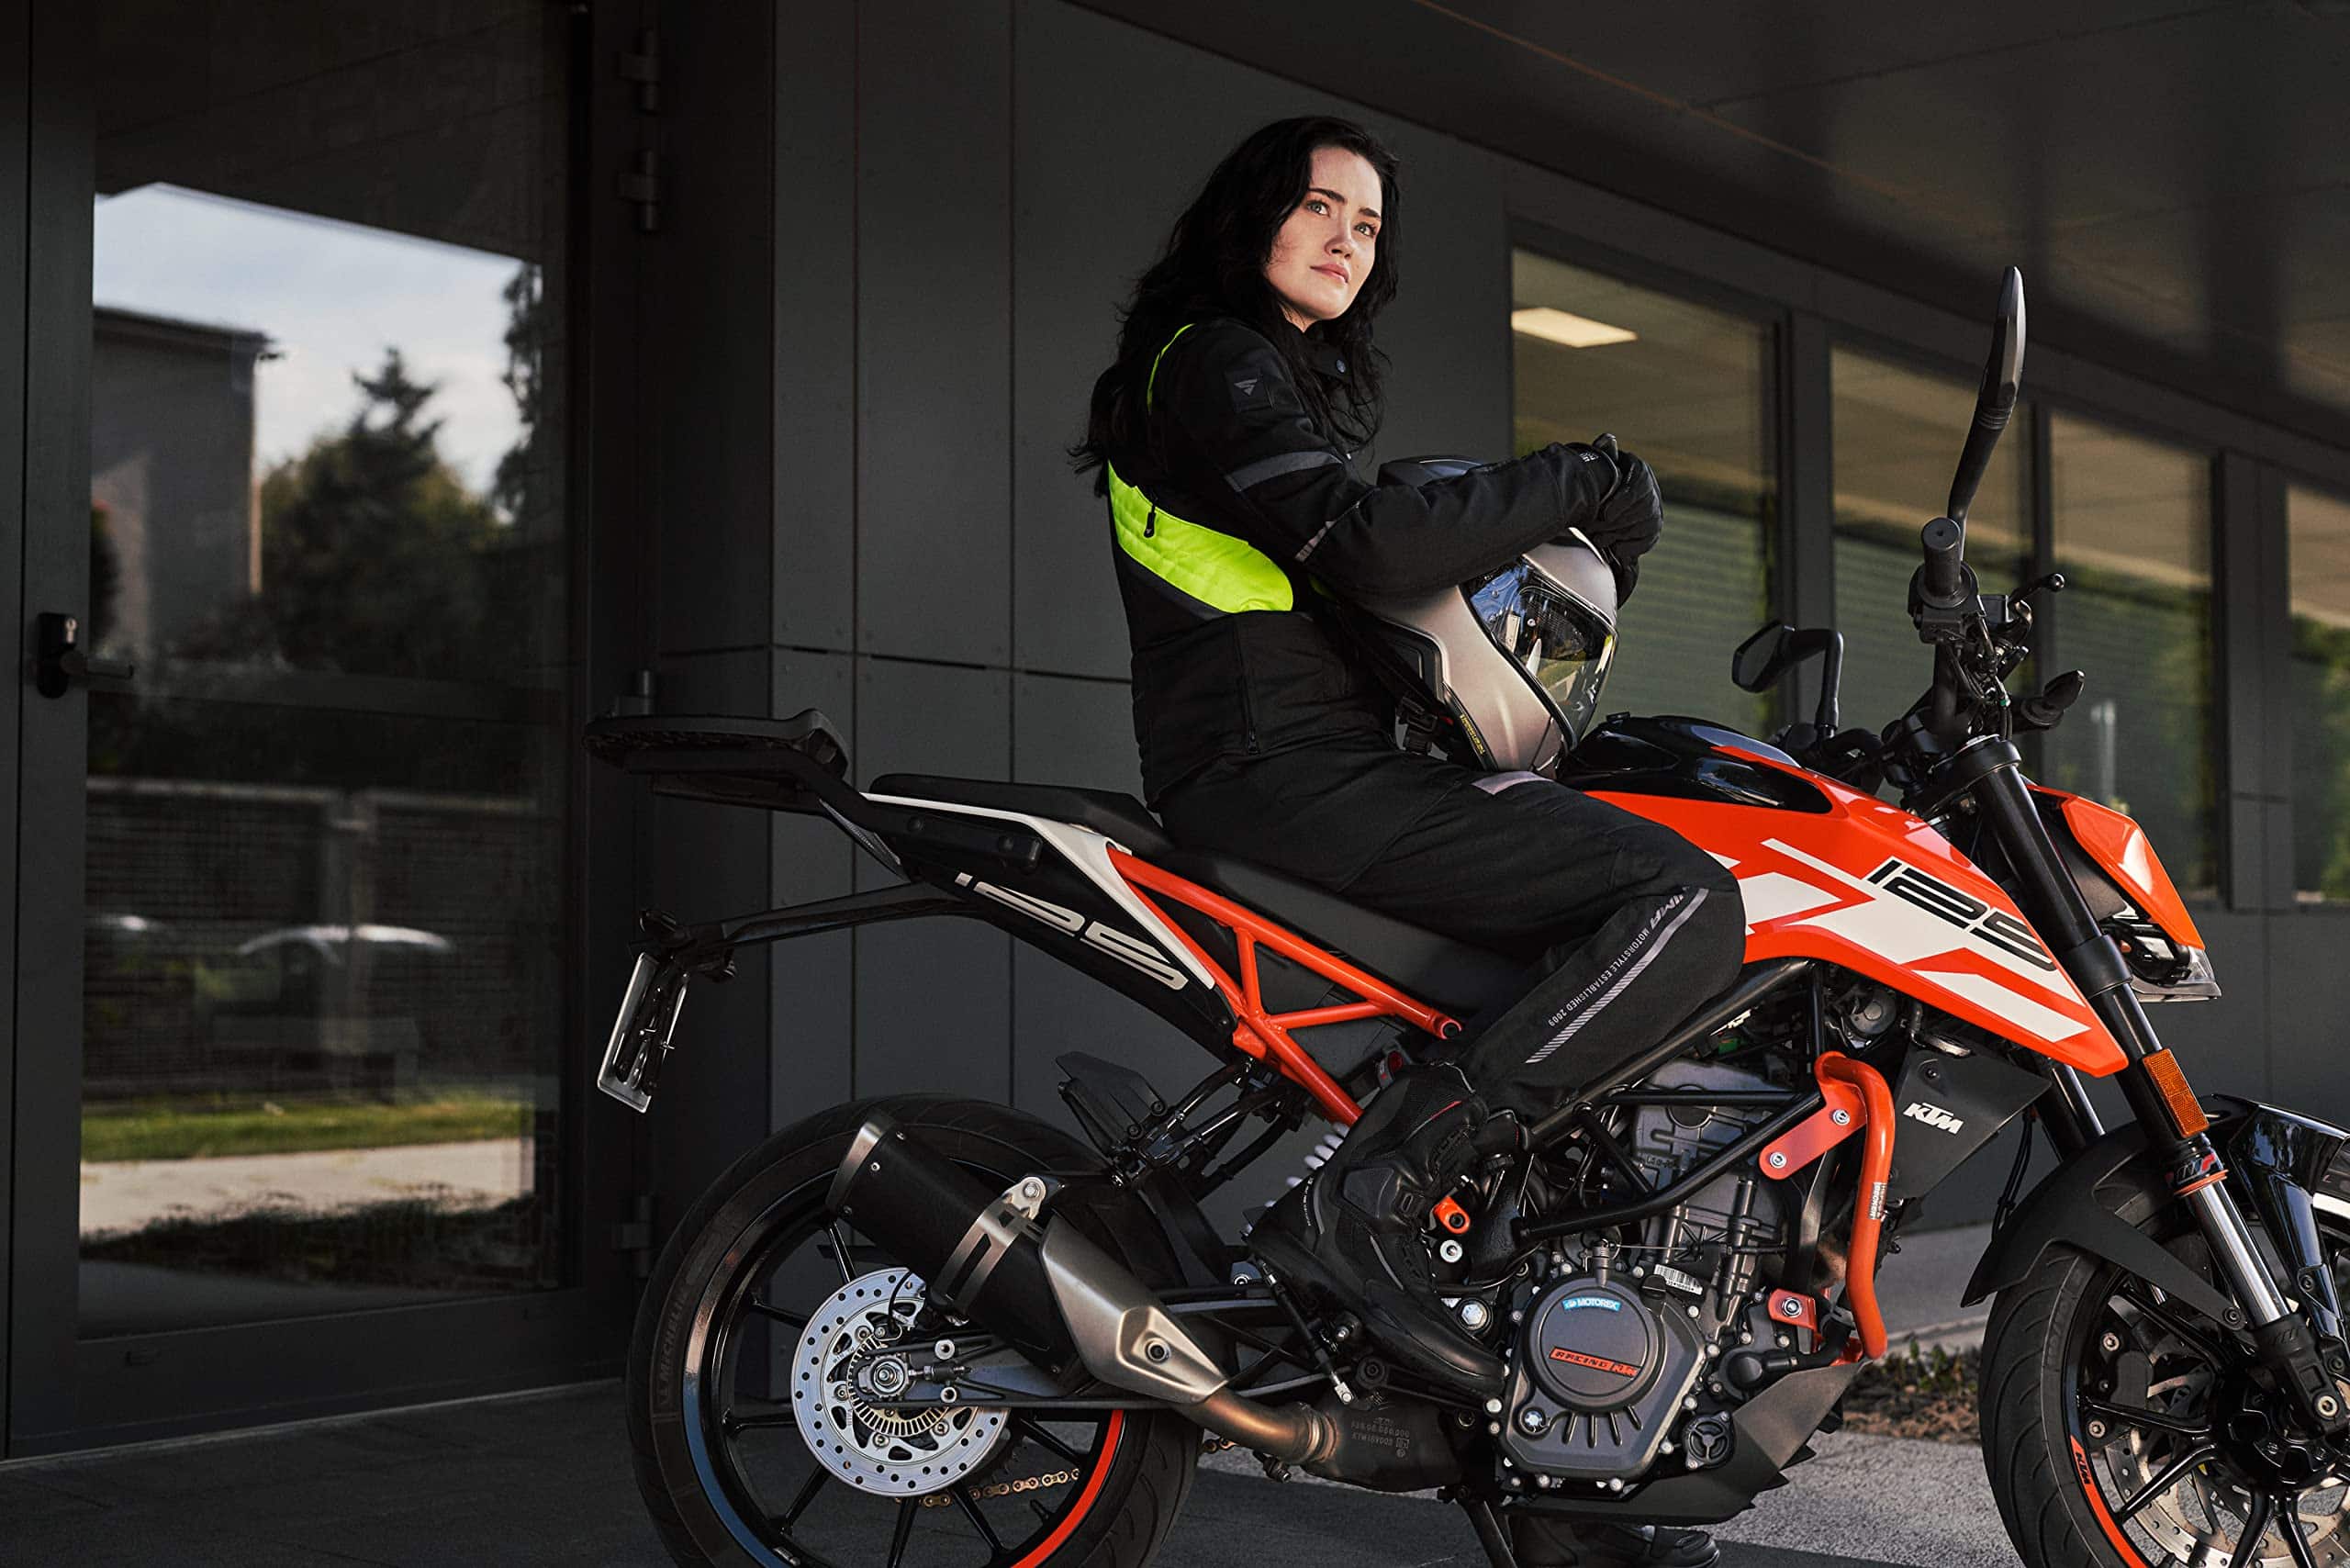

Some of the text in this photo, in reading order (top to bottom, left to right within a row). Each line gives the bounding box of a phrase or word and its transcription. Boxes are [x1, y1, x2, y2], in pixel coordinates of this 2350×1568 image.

[1609, 927, 1651, 972] MOTORSTYLE
[1566, 969, 1613, 1012] ESTABLISHED
[1548, 1009, 1567, 1027] 2009
[1903, 1102, 1964, 1135] KTM
[1578, 1297, 1617, 1310] MOTOREX
